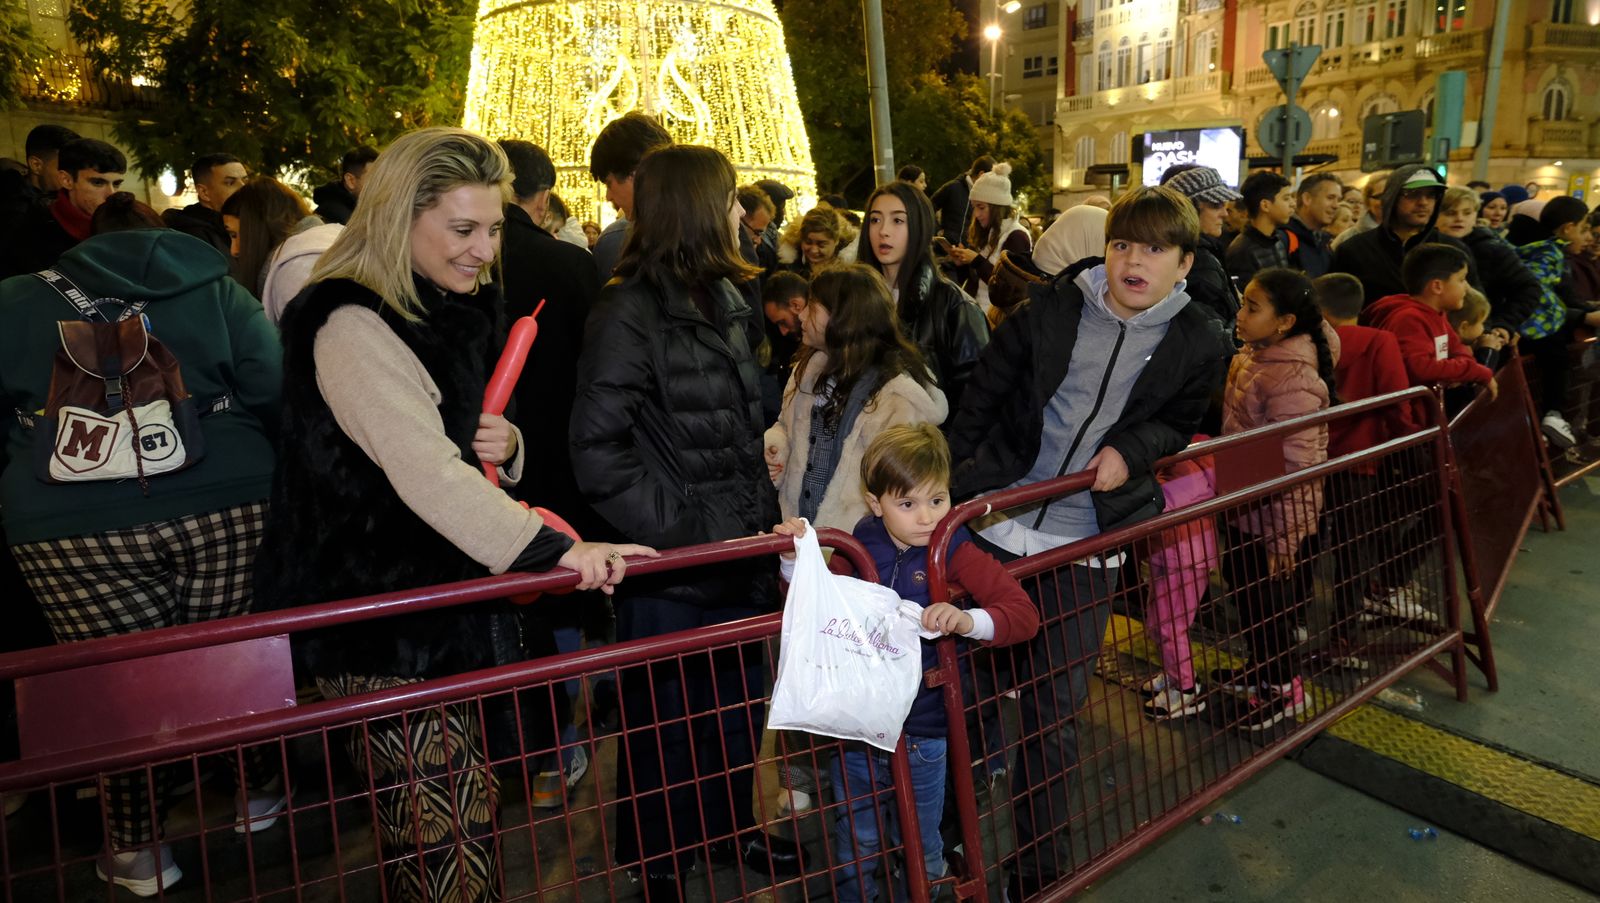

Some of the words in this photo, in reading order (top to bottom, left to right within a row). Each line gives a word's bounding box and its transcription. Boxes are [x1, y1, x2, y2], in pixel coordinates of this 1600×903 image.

[1151, 141, 1185, 151] NUEVO
[62, 419, 110, 463] M
[140, 431, 169, 452] 67
[819, 618, 837, 635] La
